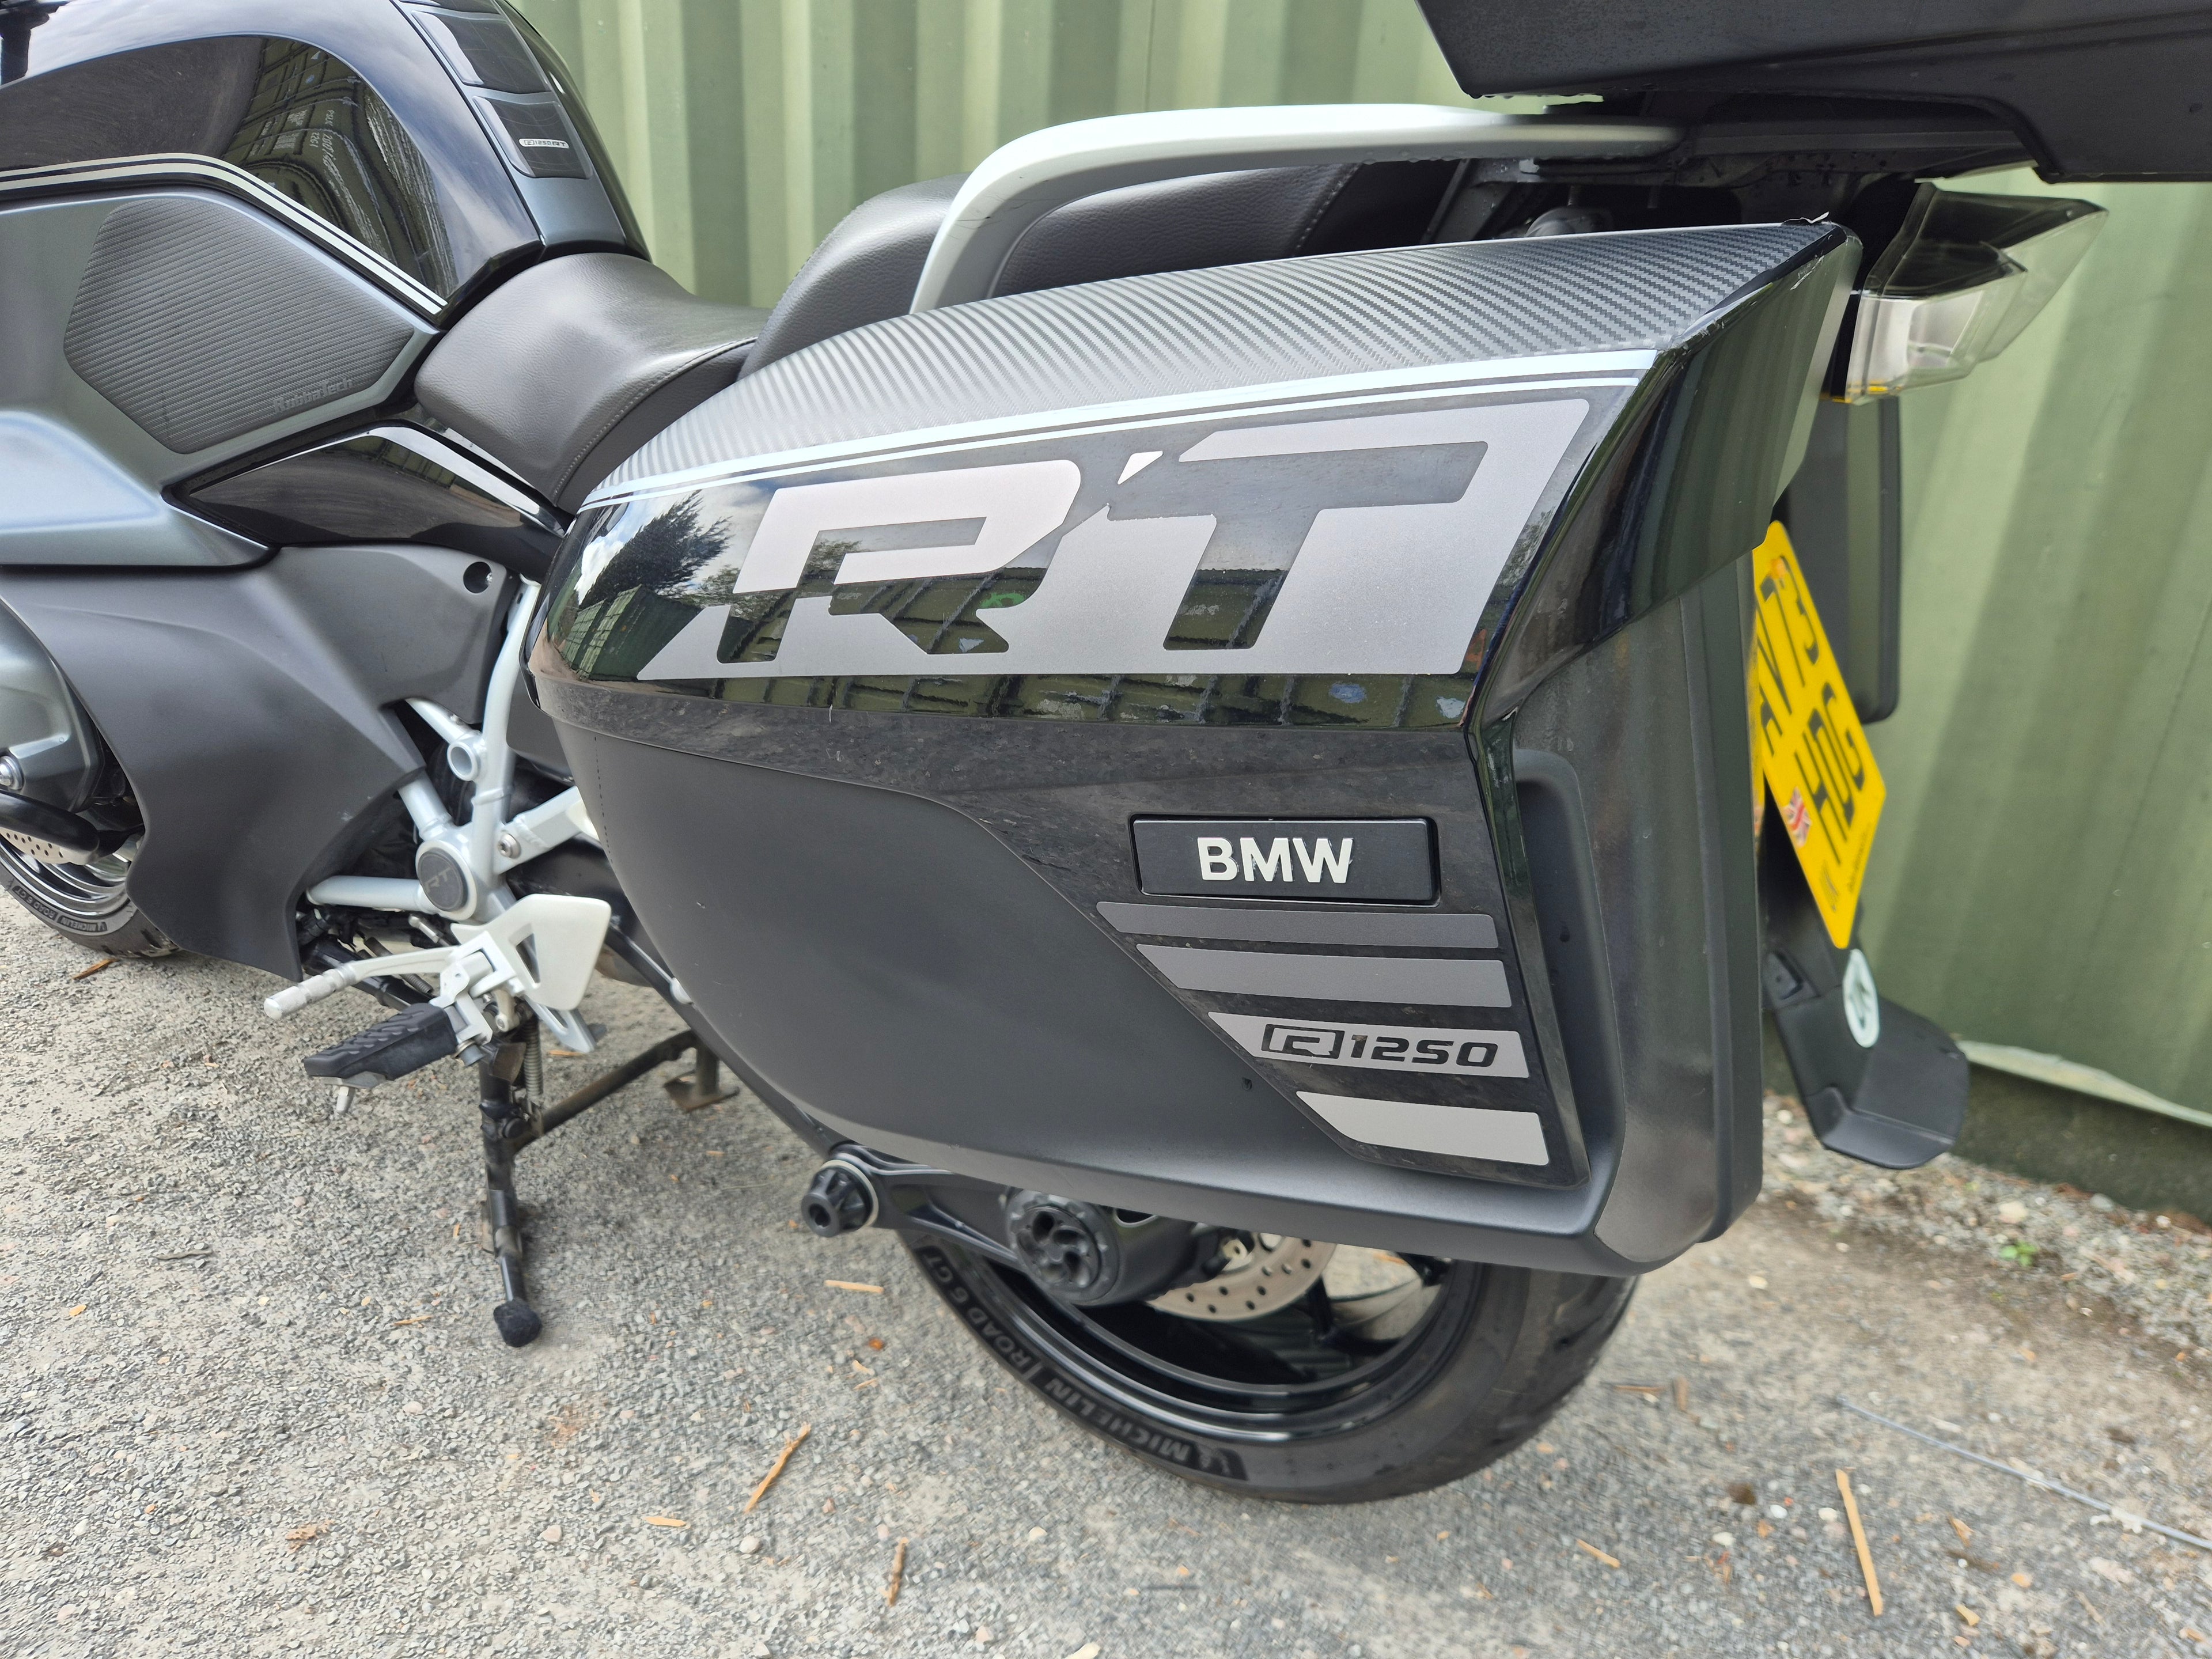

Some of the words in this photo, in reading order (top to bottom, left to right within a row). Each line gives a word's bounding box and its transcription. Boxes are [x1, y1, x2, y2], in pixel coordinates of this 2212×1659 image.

[273, 378, 354, 414] RubbaTech
[637, 399, 1589, 681] RT
[1794, 682, 1865, 865] HDG
[1196, 836, 1354, 884] BMW
[14, 887, 27, 899] GT
[425, 866, 452, 892] RT
[28, 896, 34, 904] 6
[33, 901, 56, 918] ROAD
[60, 916, 96, 931] MICHELIN
[924, 1251, 953, 1282] GT
[950, 1286, 969, 1303] 6
[967, 1307, 1032, 1368] ROAD
[1045, 1378, 1191, 1461] MICHELIN
